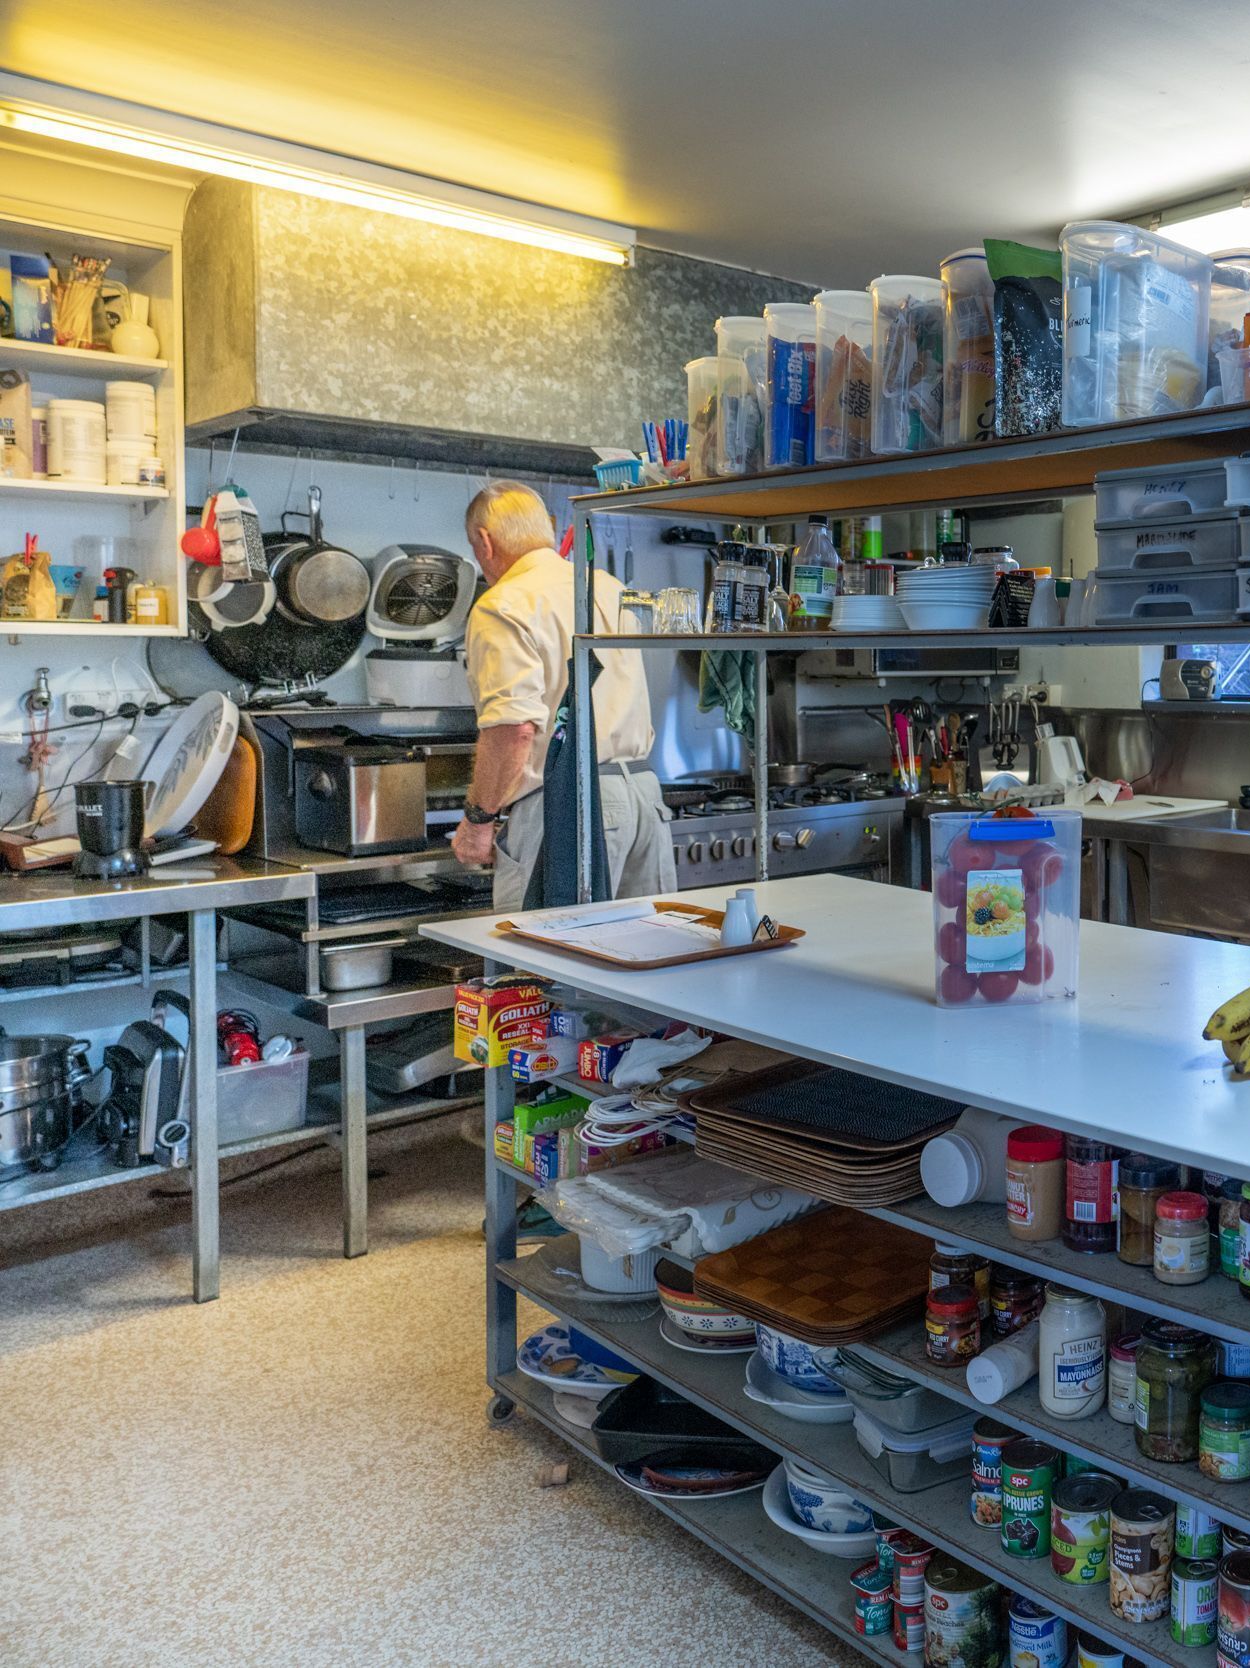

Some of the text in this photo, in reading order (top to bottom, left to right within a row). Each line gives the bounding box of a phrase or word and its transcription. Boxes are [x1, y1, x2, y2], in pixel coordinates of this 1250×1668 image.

[853, 378, 872, 420] Right
[1147, 583, 1179, 594] JAM
[519, 988, 544, 999] VALU
[499, 1001, 550, 1023] GOLIATH
[502, 1029, 530, 1040] RESEAL
[583, 1046, 592, 1077] JUMBO
[1069, 1340, 1098, 1354] HEINZ
[1060, 1361, 1104, 1381] MAYONNAISE
[972, 1458, 1001, 1478] Salmo
[1011, 1476, 1029, 1488] spc
[1006, 1494, 1044, 1512] PRUNES
[1114, 1550, 1134, 1562] Pieces
[1134, 1554, 1142, 1562] &
[1115, 1557, 1134, 1569] Stems
[931, 1596, 946, 1609] spc
[1011, 1621, 1037, 1636] Nestlé
[1036, 1639, 1053, 1651] Milk
